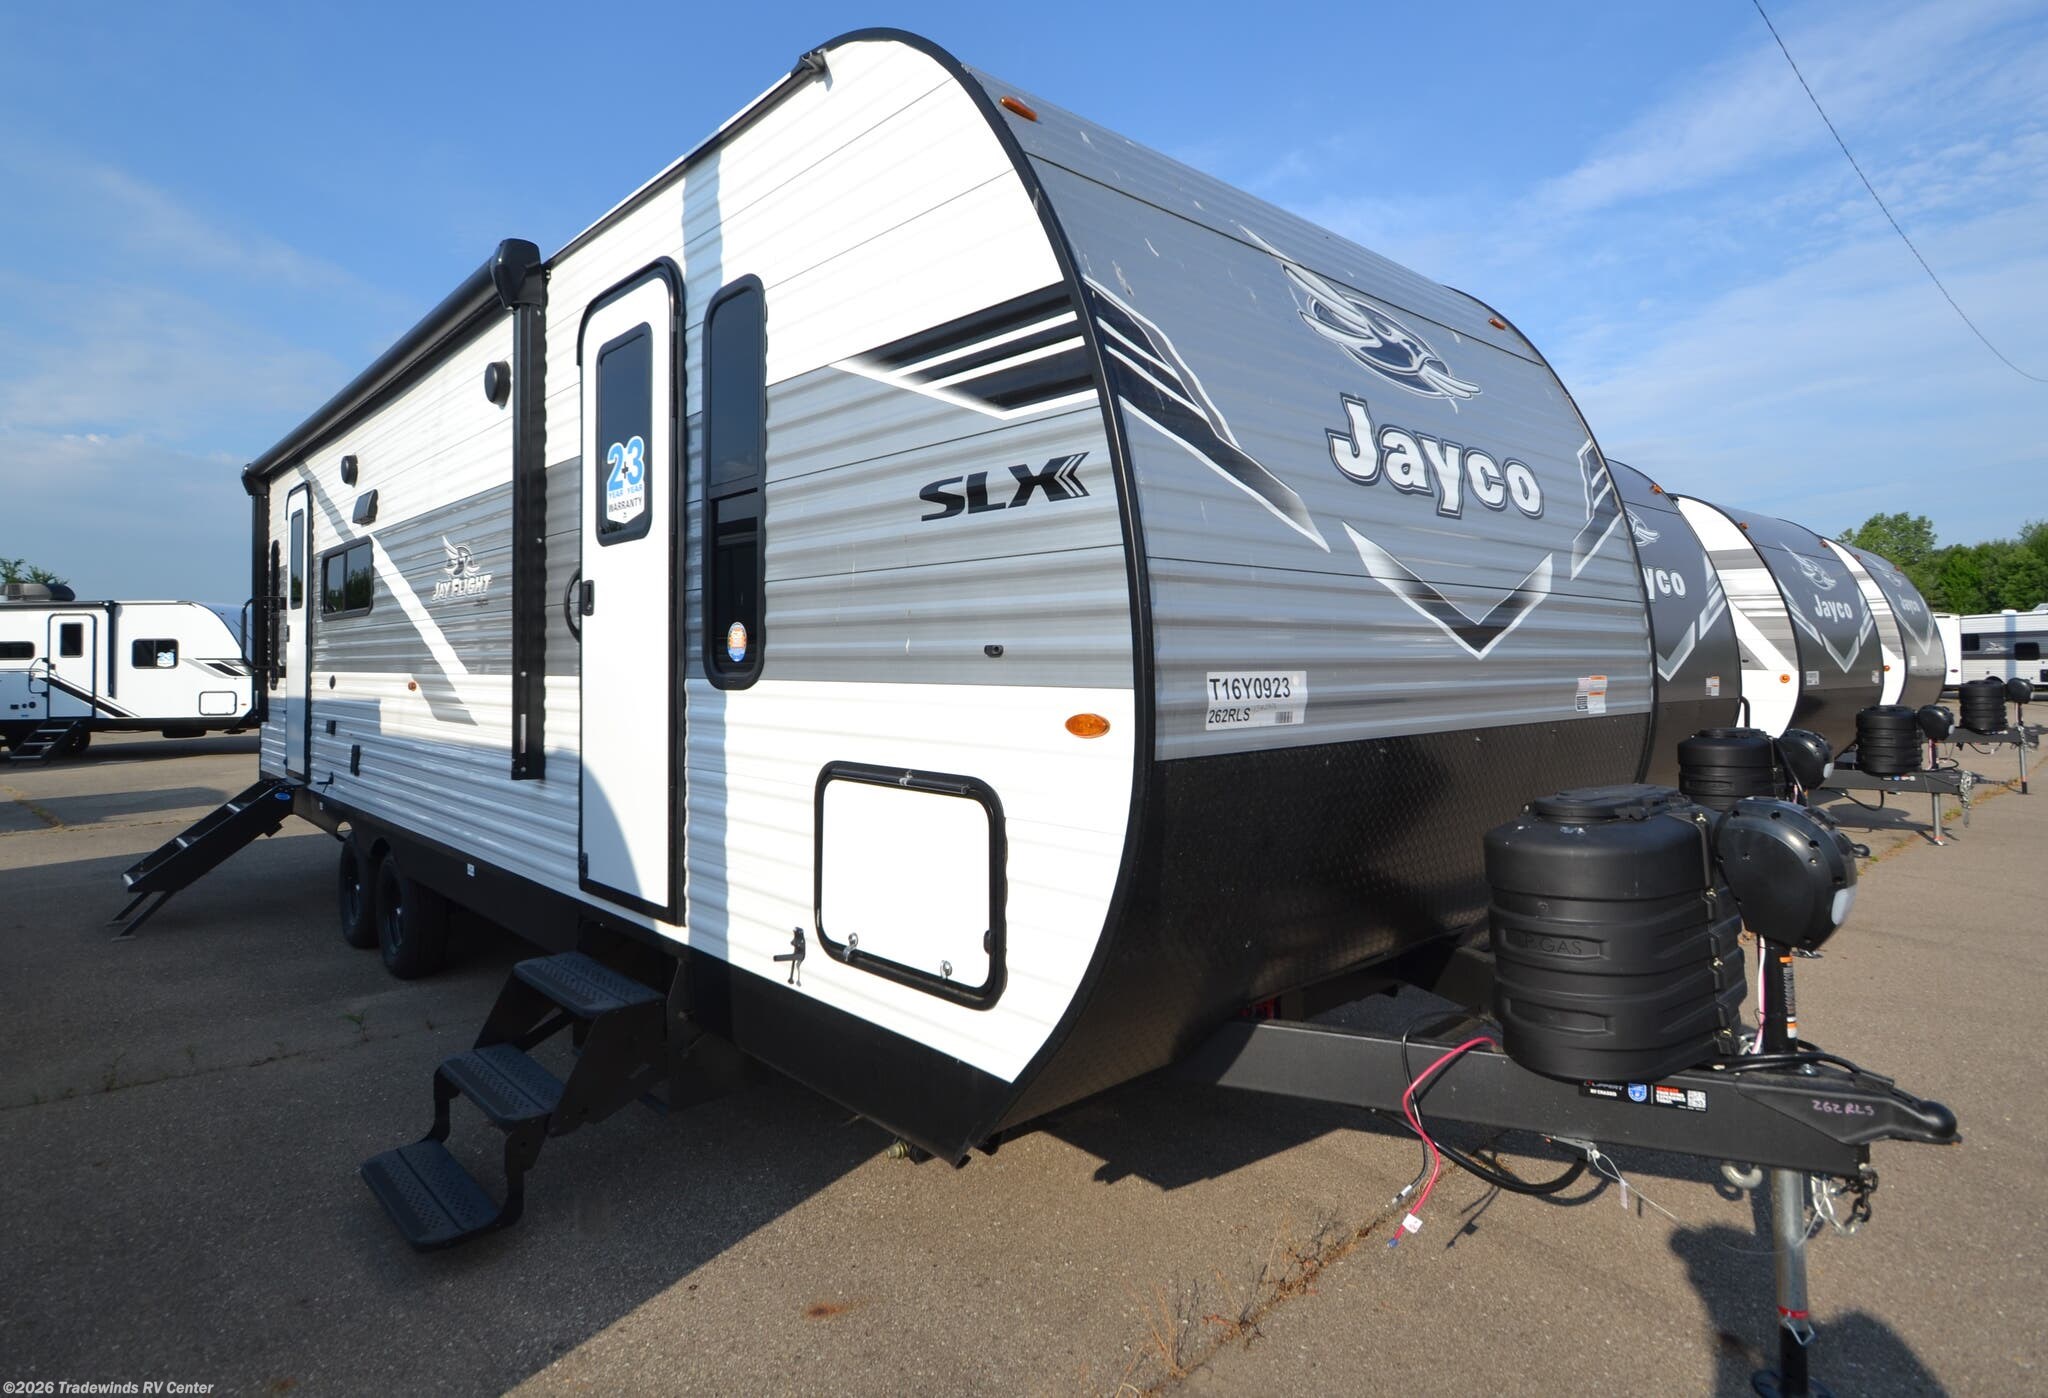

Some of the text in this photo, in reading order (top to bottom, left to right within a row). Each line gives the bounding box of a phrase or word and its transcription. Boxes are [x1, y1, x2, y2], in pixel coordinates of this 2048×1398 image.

[1325, 392, 1545, 520] Jayco
[919, 452, 1090, 522] SLX
[608, 497, 643, 513] WARRANTY
[432, 574, 492, 601] JAY FLIGHT
[1642, 567, 1686, 600] yco
[1814, 594, 1853, 624] Jayco
[1209, 677, 1291, 701] T16Y0923
[1208, 707, 1251, 724] 262RLS
[1812, 1100, 1843, 1114] 262
